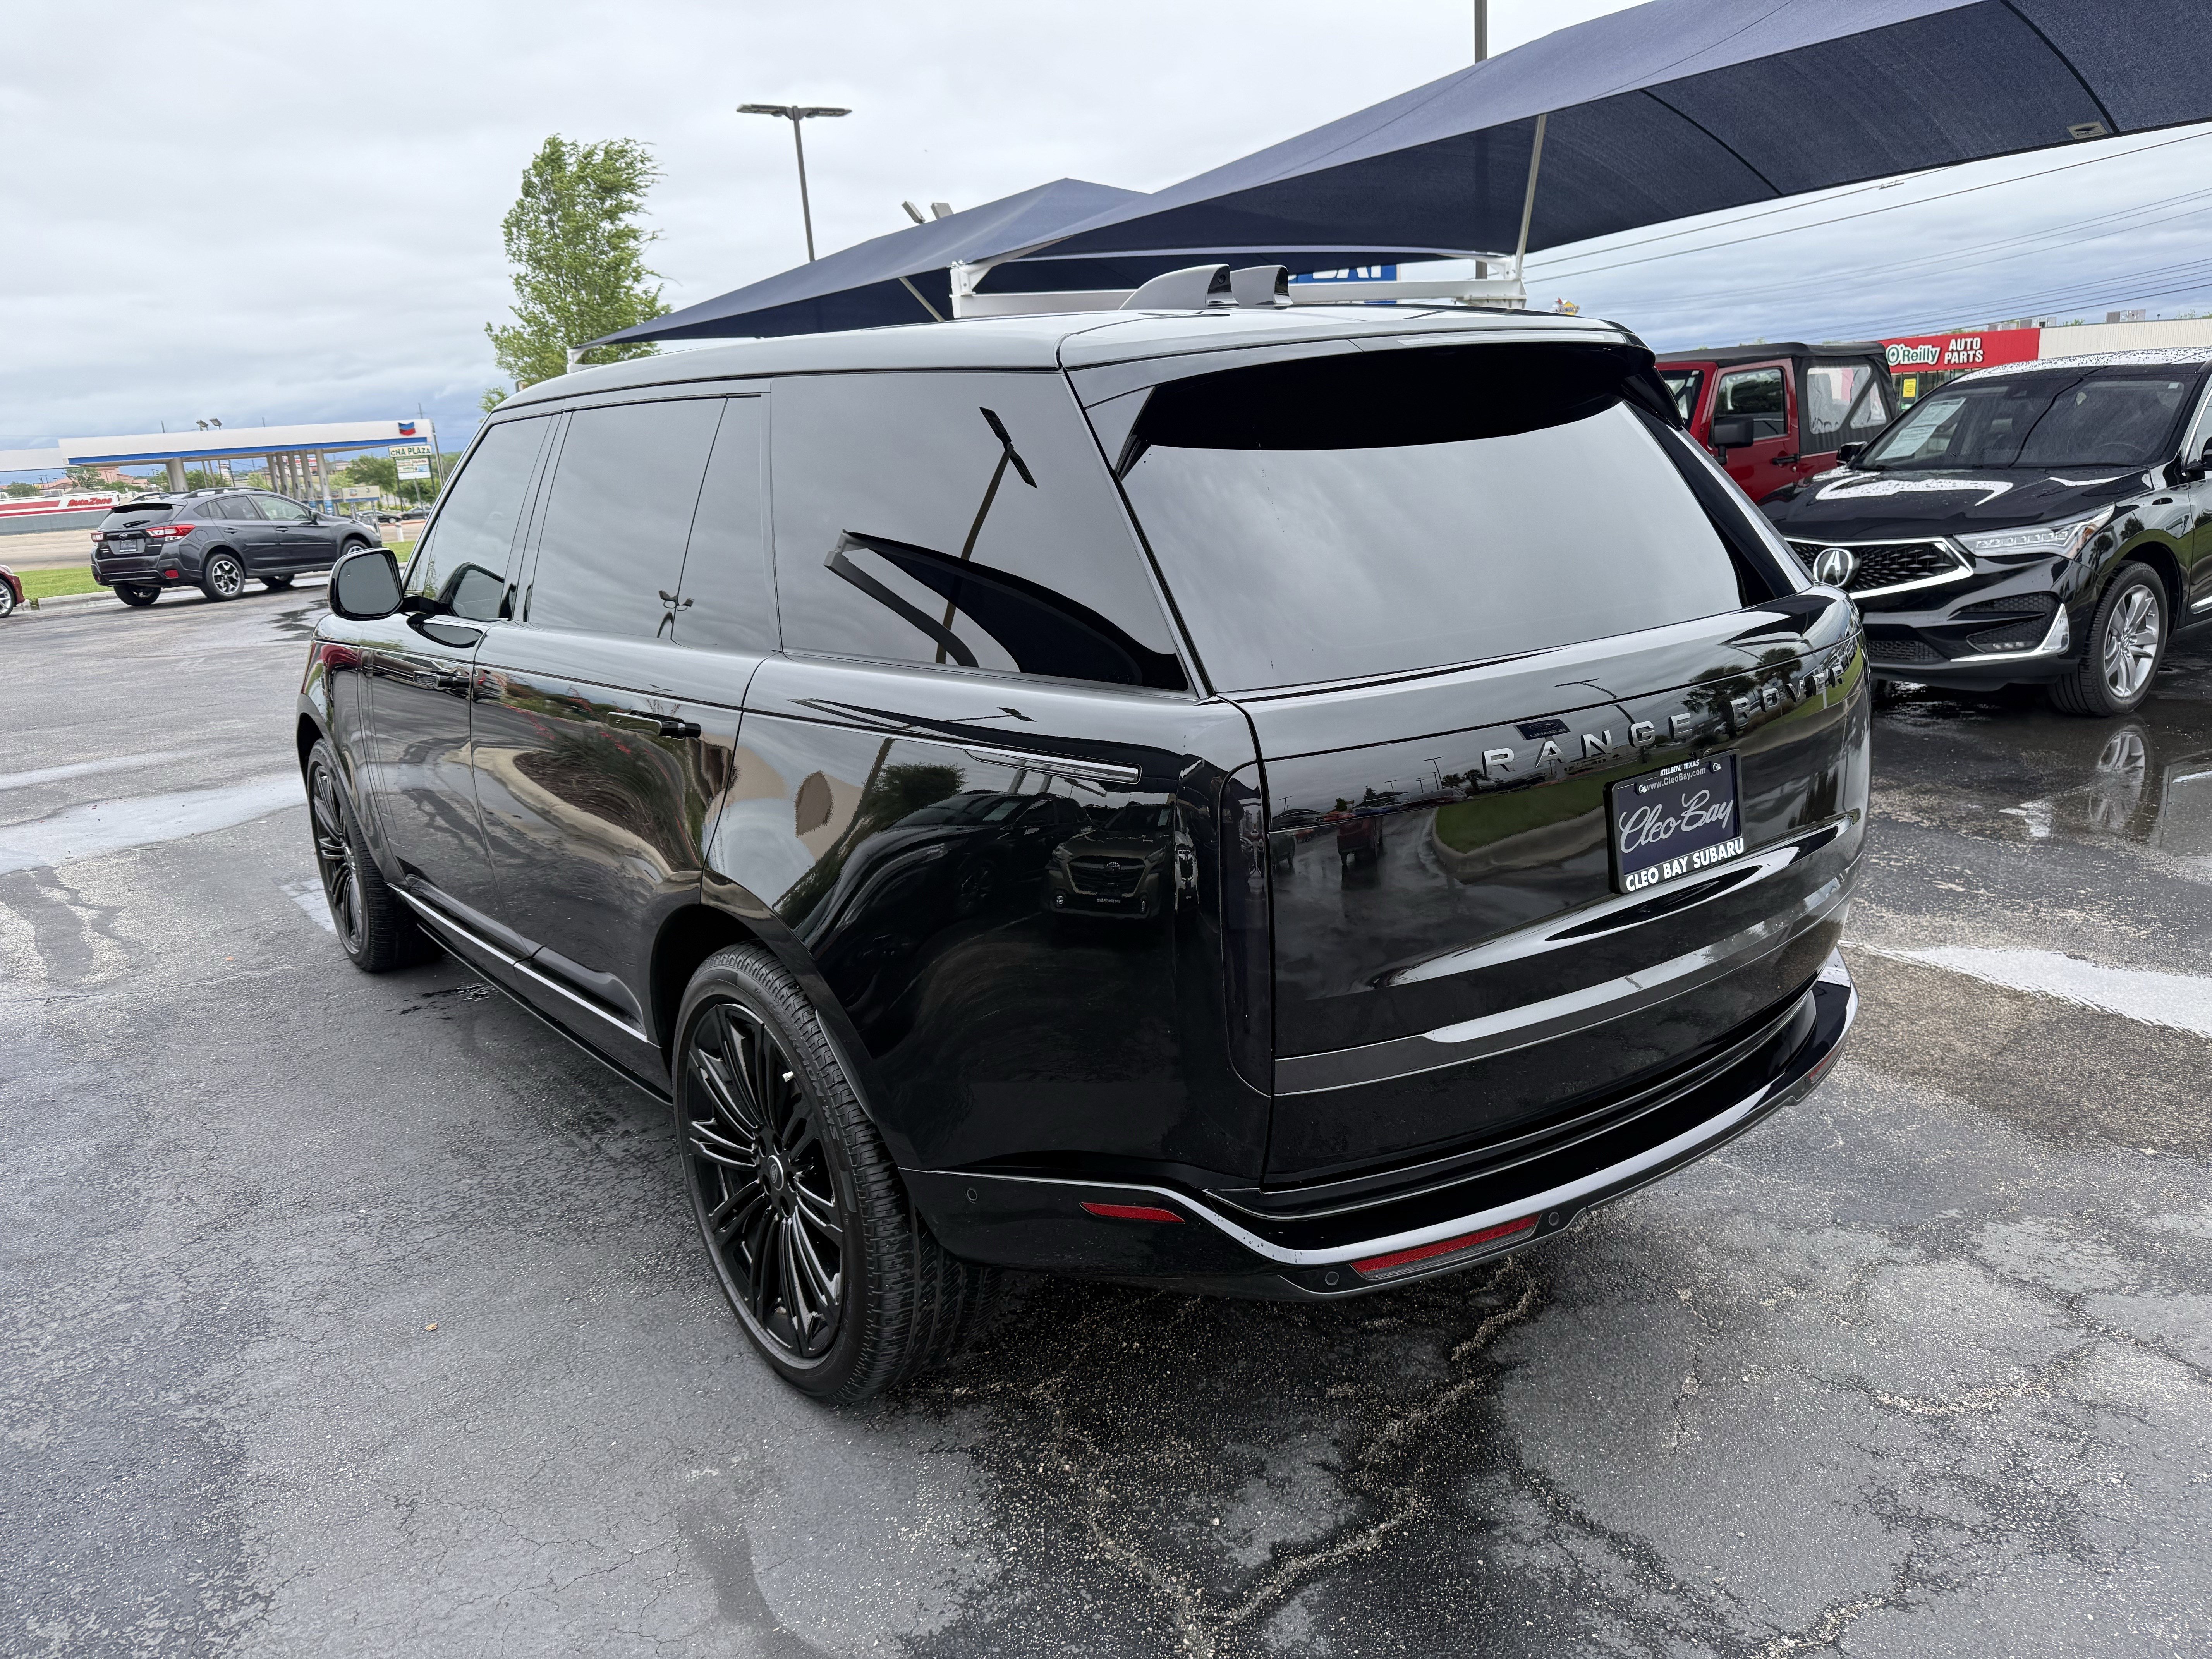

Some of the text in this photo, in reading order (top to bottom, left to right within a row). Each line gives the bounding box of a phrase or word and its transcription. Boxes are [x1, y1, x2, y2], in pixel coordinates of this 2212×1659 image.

[1948, 337, 1981, 351] AUTO
[1886, 344, 1939, 365] O'Reilly
[1944, 350, 1984, 365] PARTS
[390, 448, 405, 456] CHA
[67, 497, 113, 507] AutoZone
[1482, 665, 1844, 776] RANGE ROVER
[1659, 759, 1700, 777] KILLEEN, TEXAS
[1645, 767, 1706, 792] www.CleoBay.com
[1619, 789, 1734, 854] Cleo Bay
[1626, 837, 1744, 892] CLEO BAY SUBARU
